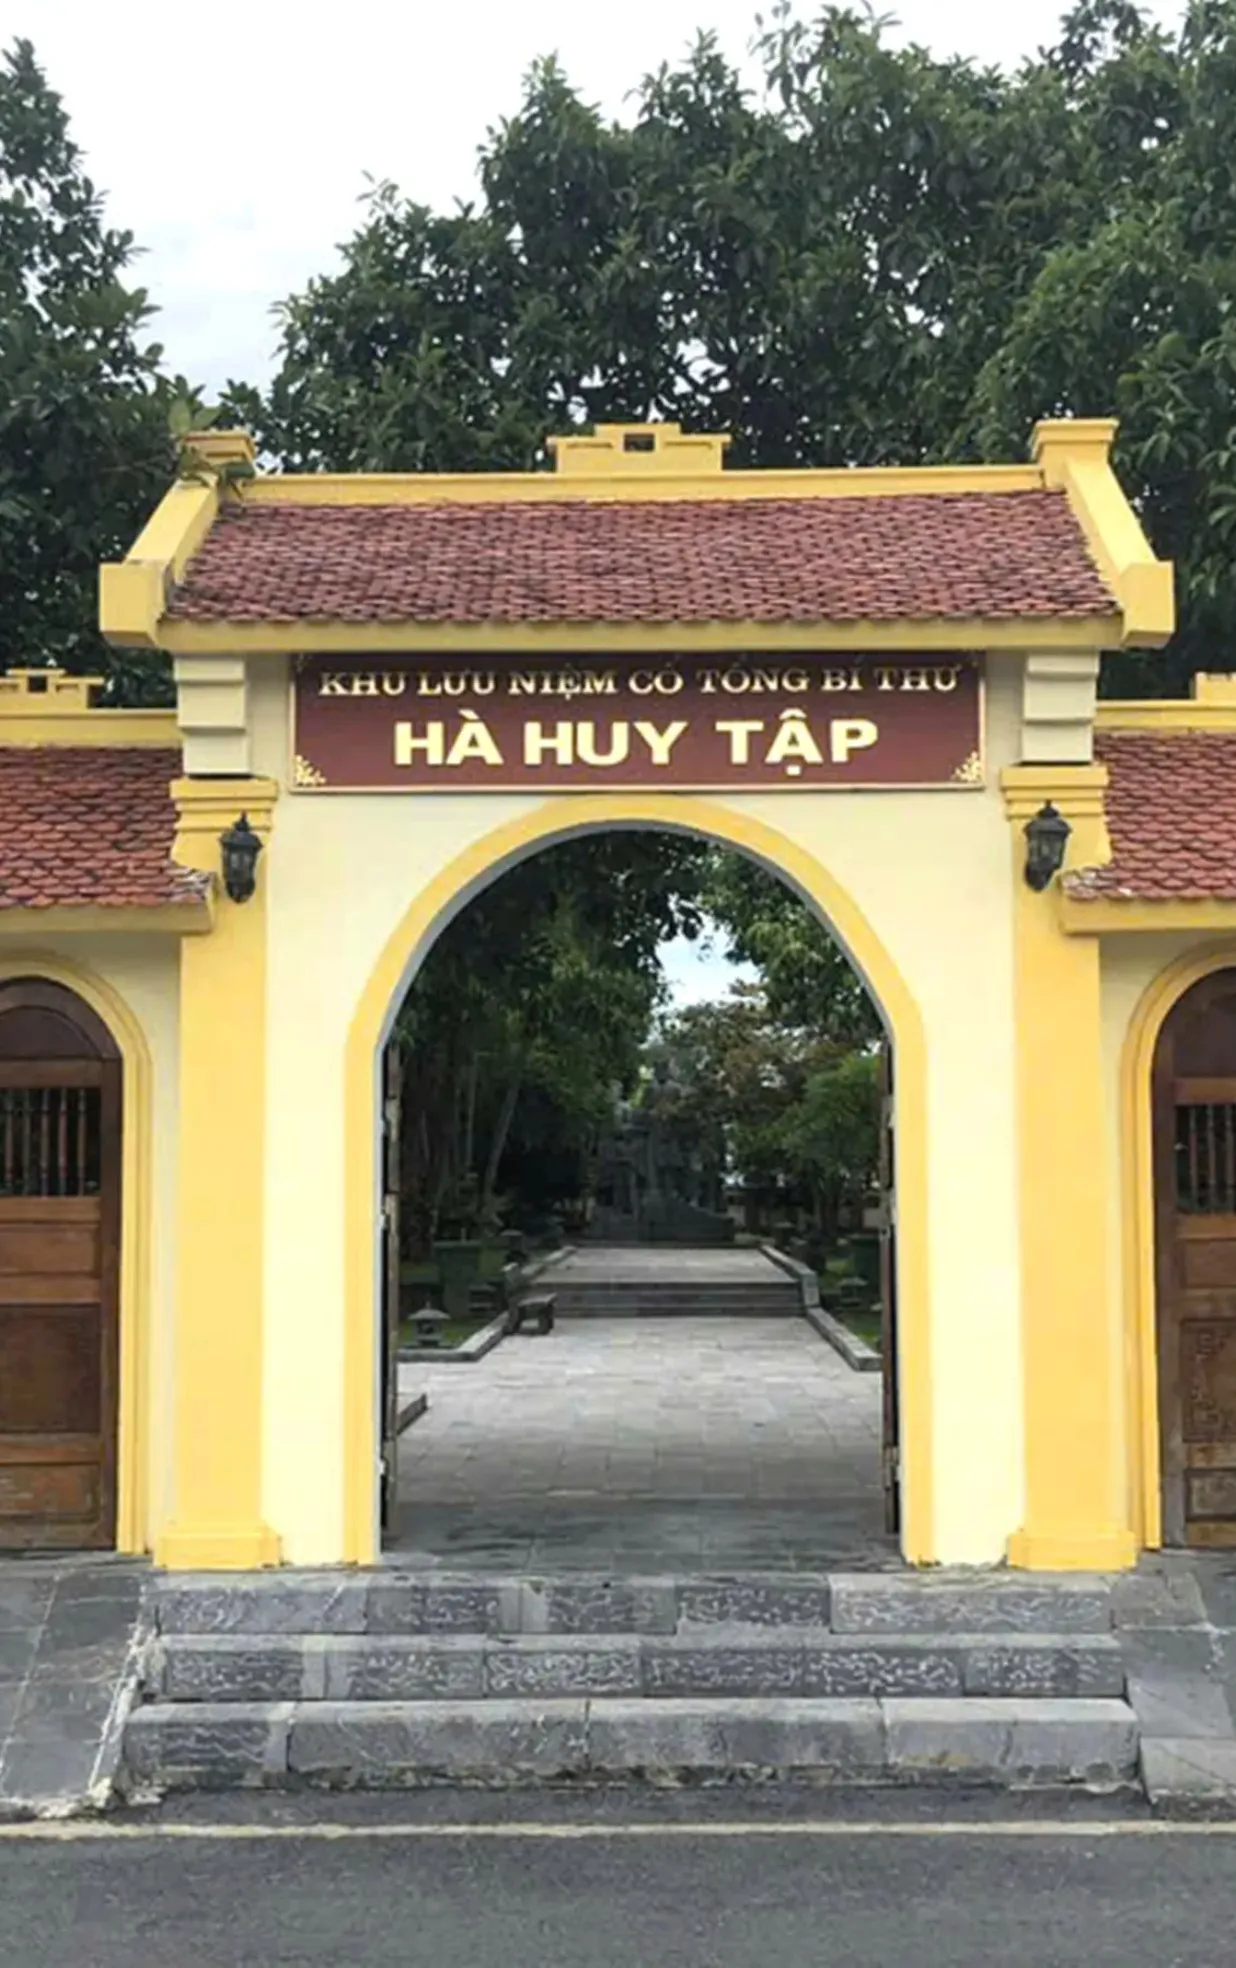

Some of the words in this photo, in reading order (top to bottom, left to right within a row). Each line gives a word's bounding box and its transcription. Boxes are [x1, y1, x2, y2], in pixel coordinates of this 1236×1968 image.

[318, 672, 405, 696] KHU
[507, 663, 619, 701] NIỆM
[875, 666, 962, 692] THƯ
[393, 708, 504, 766] HÀ
[523, 720, 689, 766] HUY
[714, 707, 879, 777] TẬP
